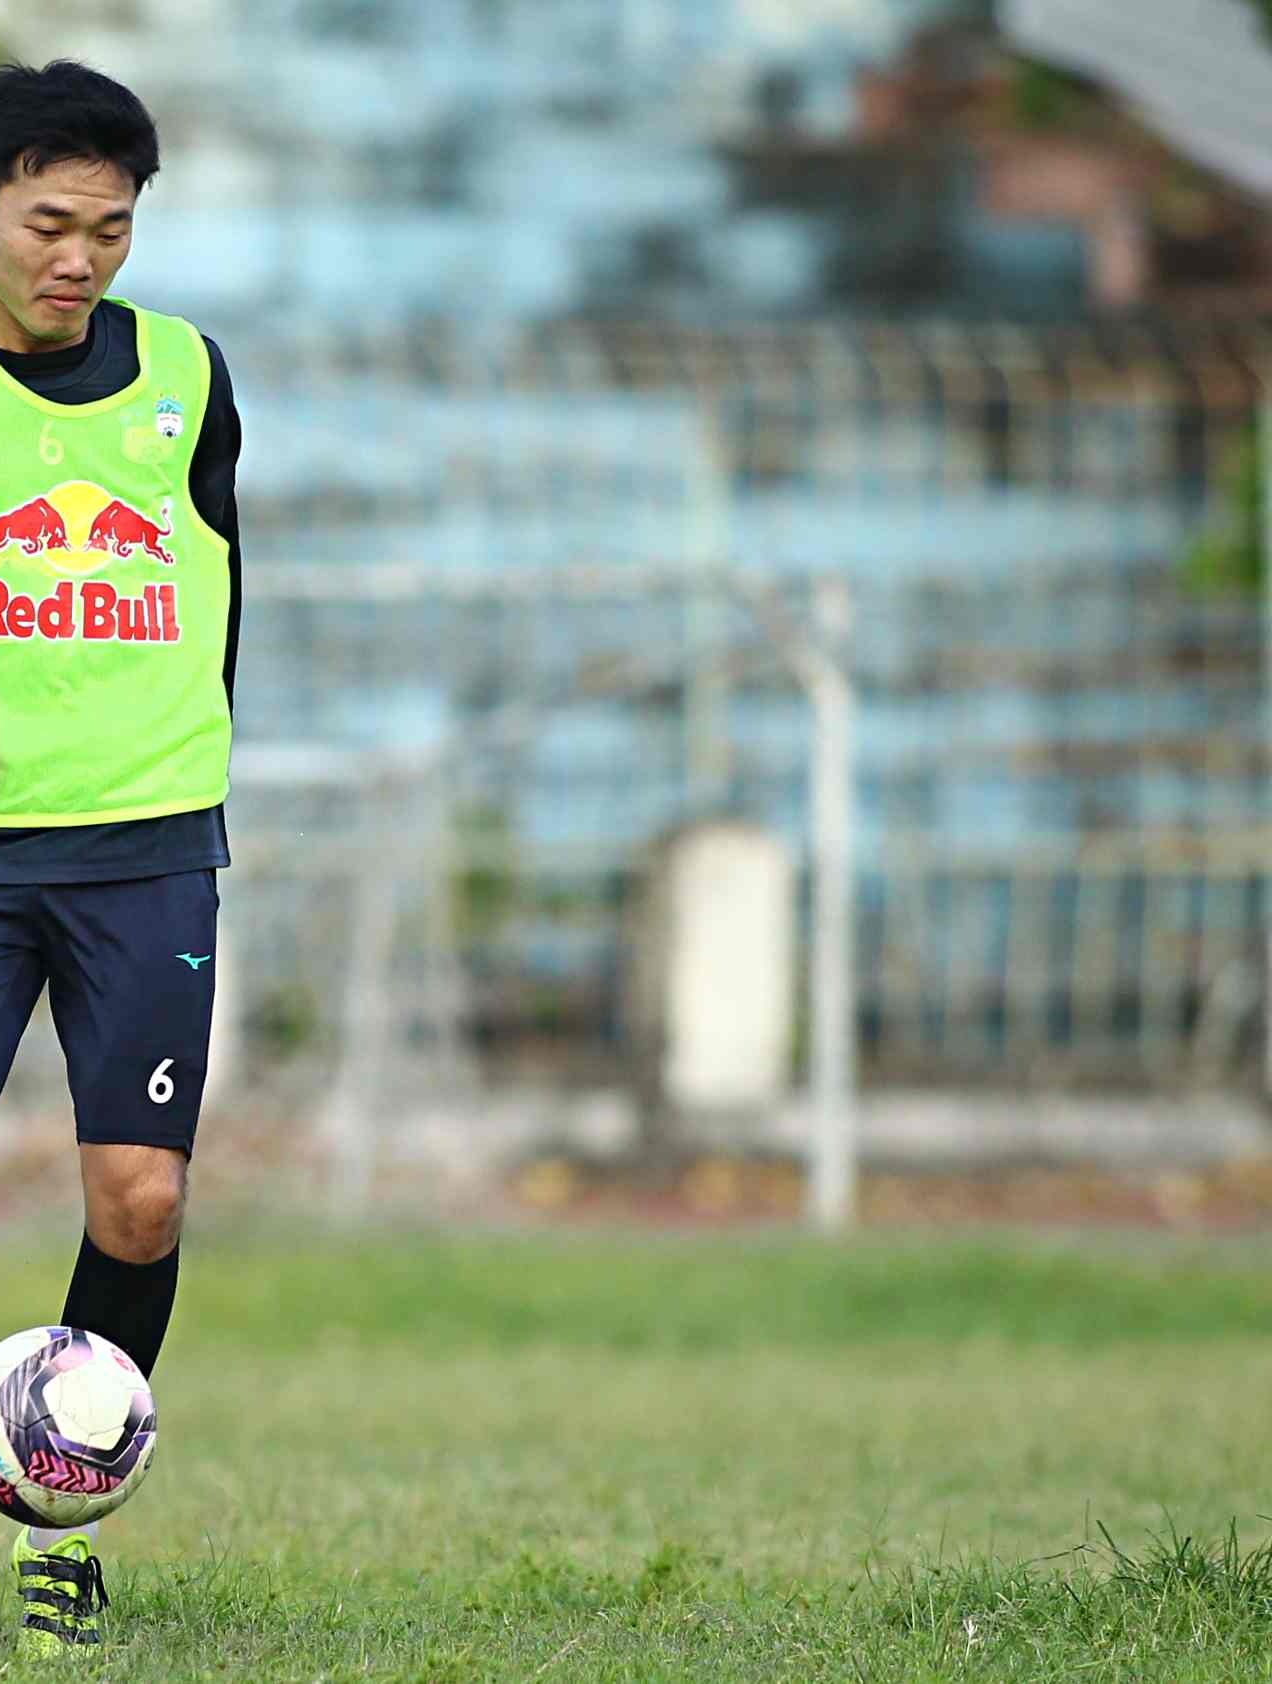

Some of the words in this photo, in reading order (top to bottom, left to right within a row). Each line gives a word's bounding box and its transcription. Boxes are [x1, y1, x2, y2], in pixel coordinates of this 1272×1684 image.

[39, 418, 64, 466] 6
[79, 581, 181, 642] Bull
[147, 1057, 175, 1104] 6
